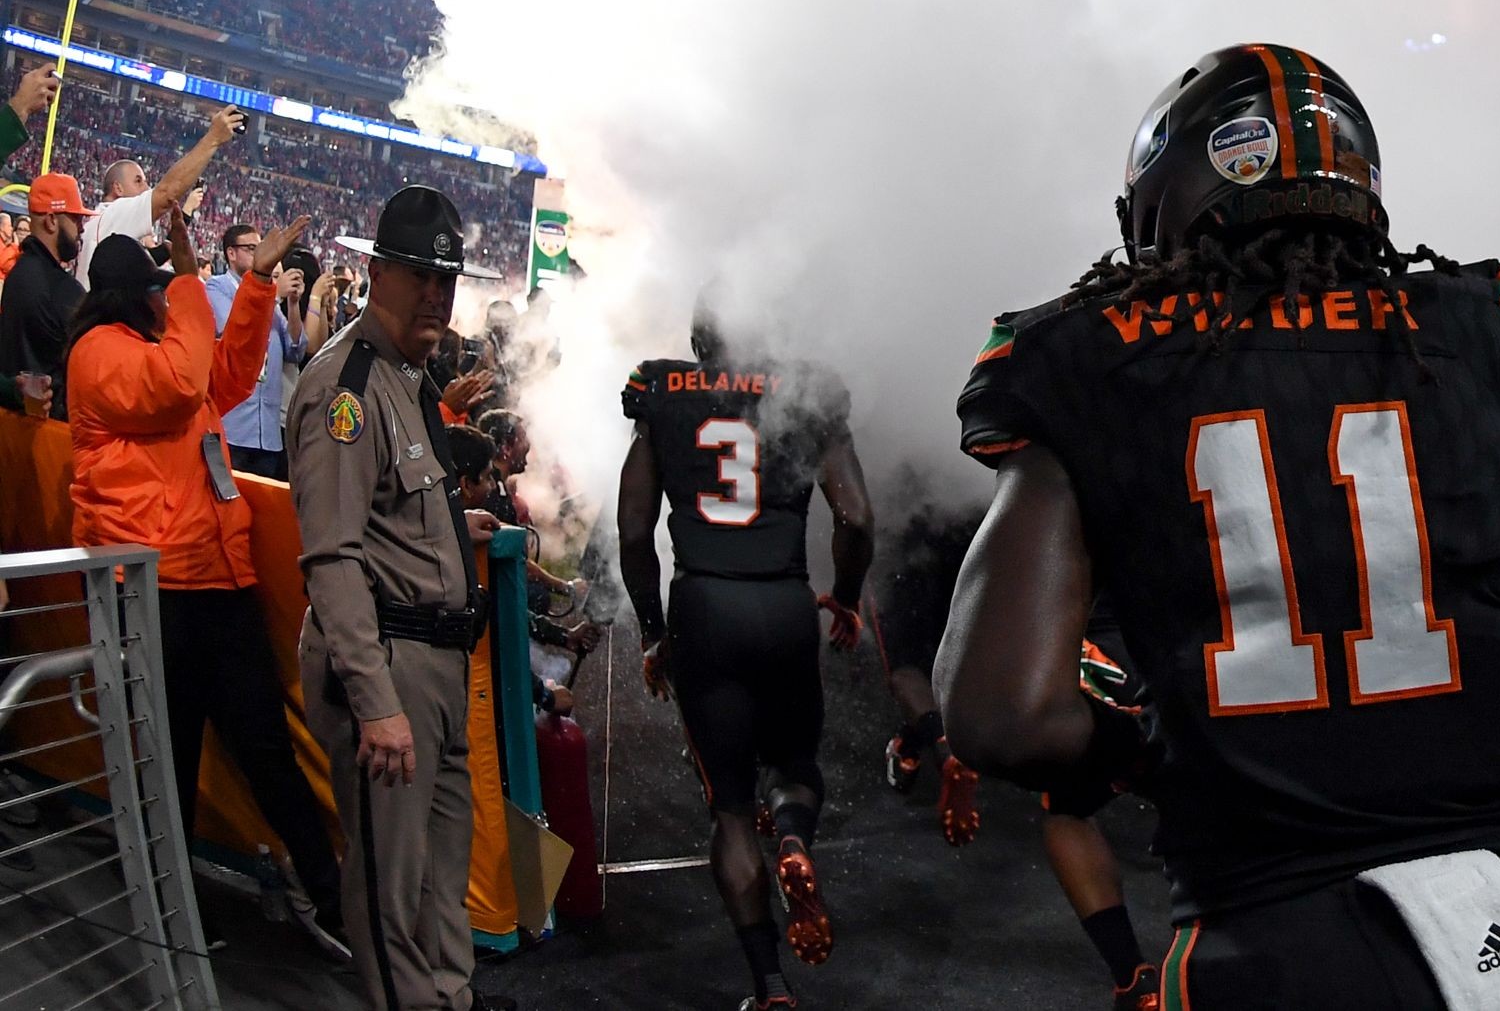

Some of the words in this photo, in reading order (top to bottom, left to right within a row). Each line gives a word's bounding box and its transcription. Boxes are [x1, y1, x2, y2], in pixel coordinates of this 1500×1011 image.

[1217, 145, 1247, 165] ORANGE
[1247, 141, 1270, 154] BOWL
[1243, 182, 1369, 225] Riddell
[667, 371, 783, 395] DELANEY
[696, 417, 761, 527] 3
[1186, 400, 1463, 718] 11
